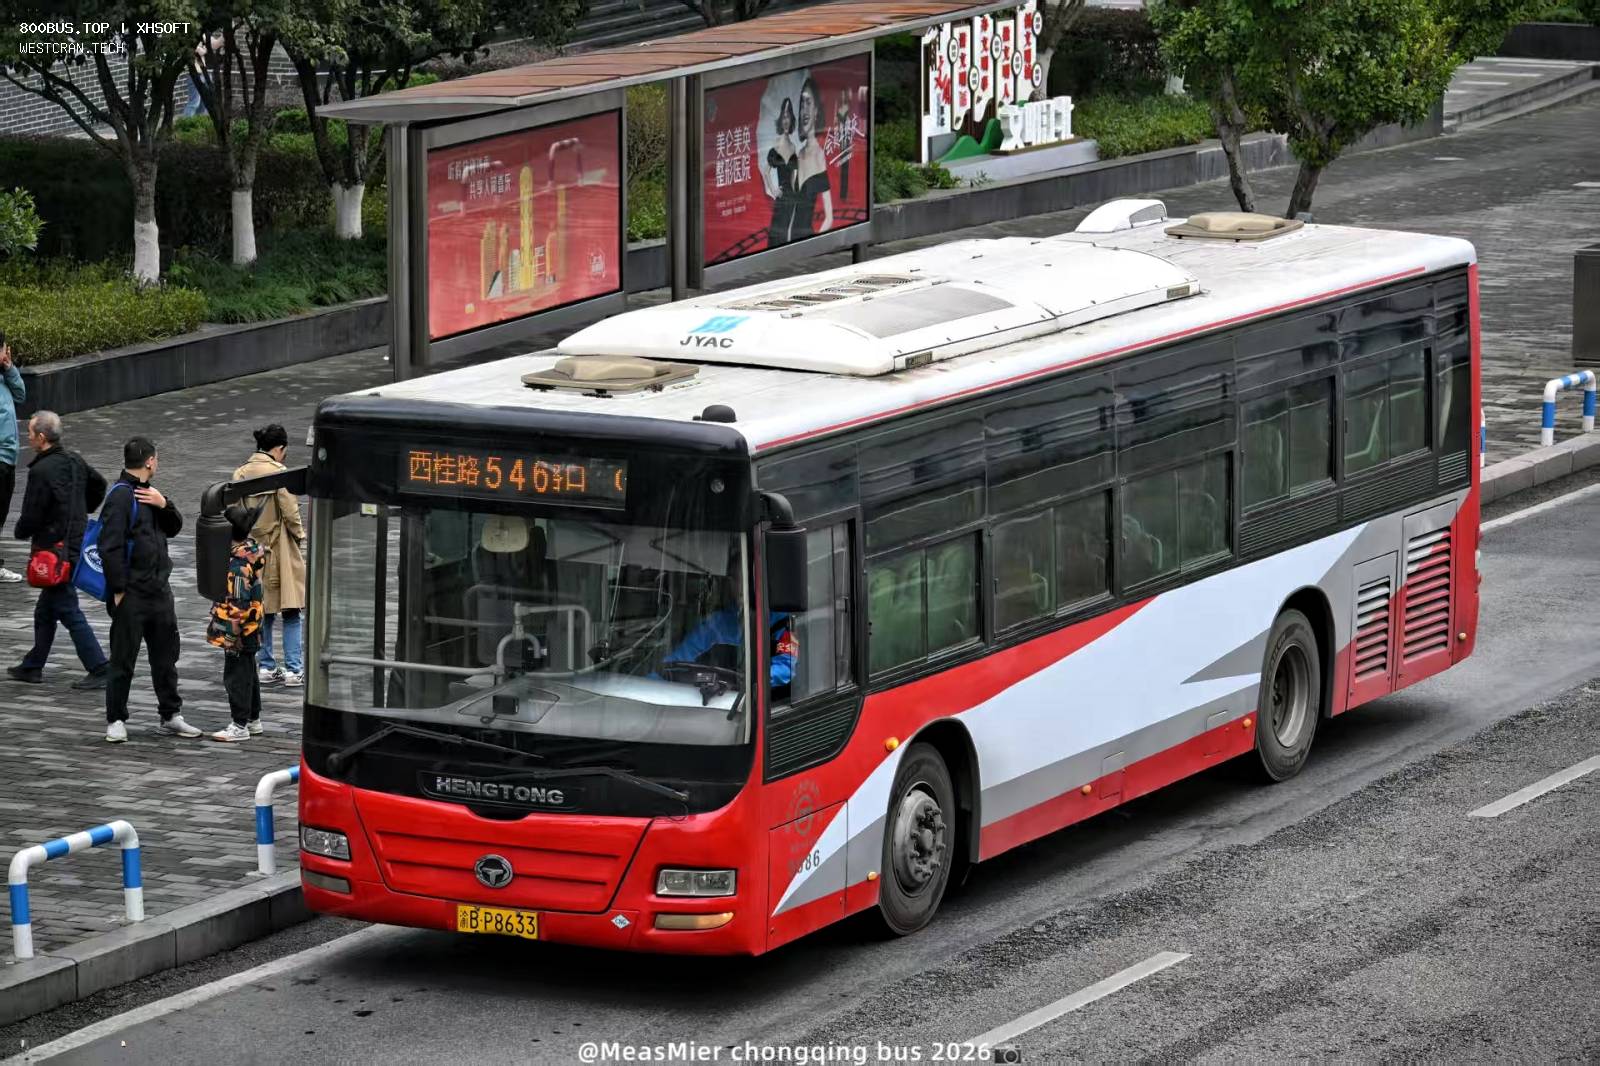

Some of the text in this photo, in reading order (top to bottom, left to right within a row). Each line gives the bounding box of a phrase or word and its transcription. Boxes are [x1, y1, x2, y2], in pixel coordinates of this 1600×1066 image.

[716, 153, 752, 188] 整形医院
[679, 335, 735, 348] JYAC
[435, 776, 565, 804] HENGTONG
